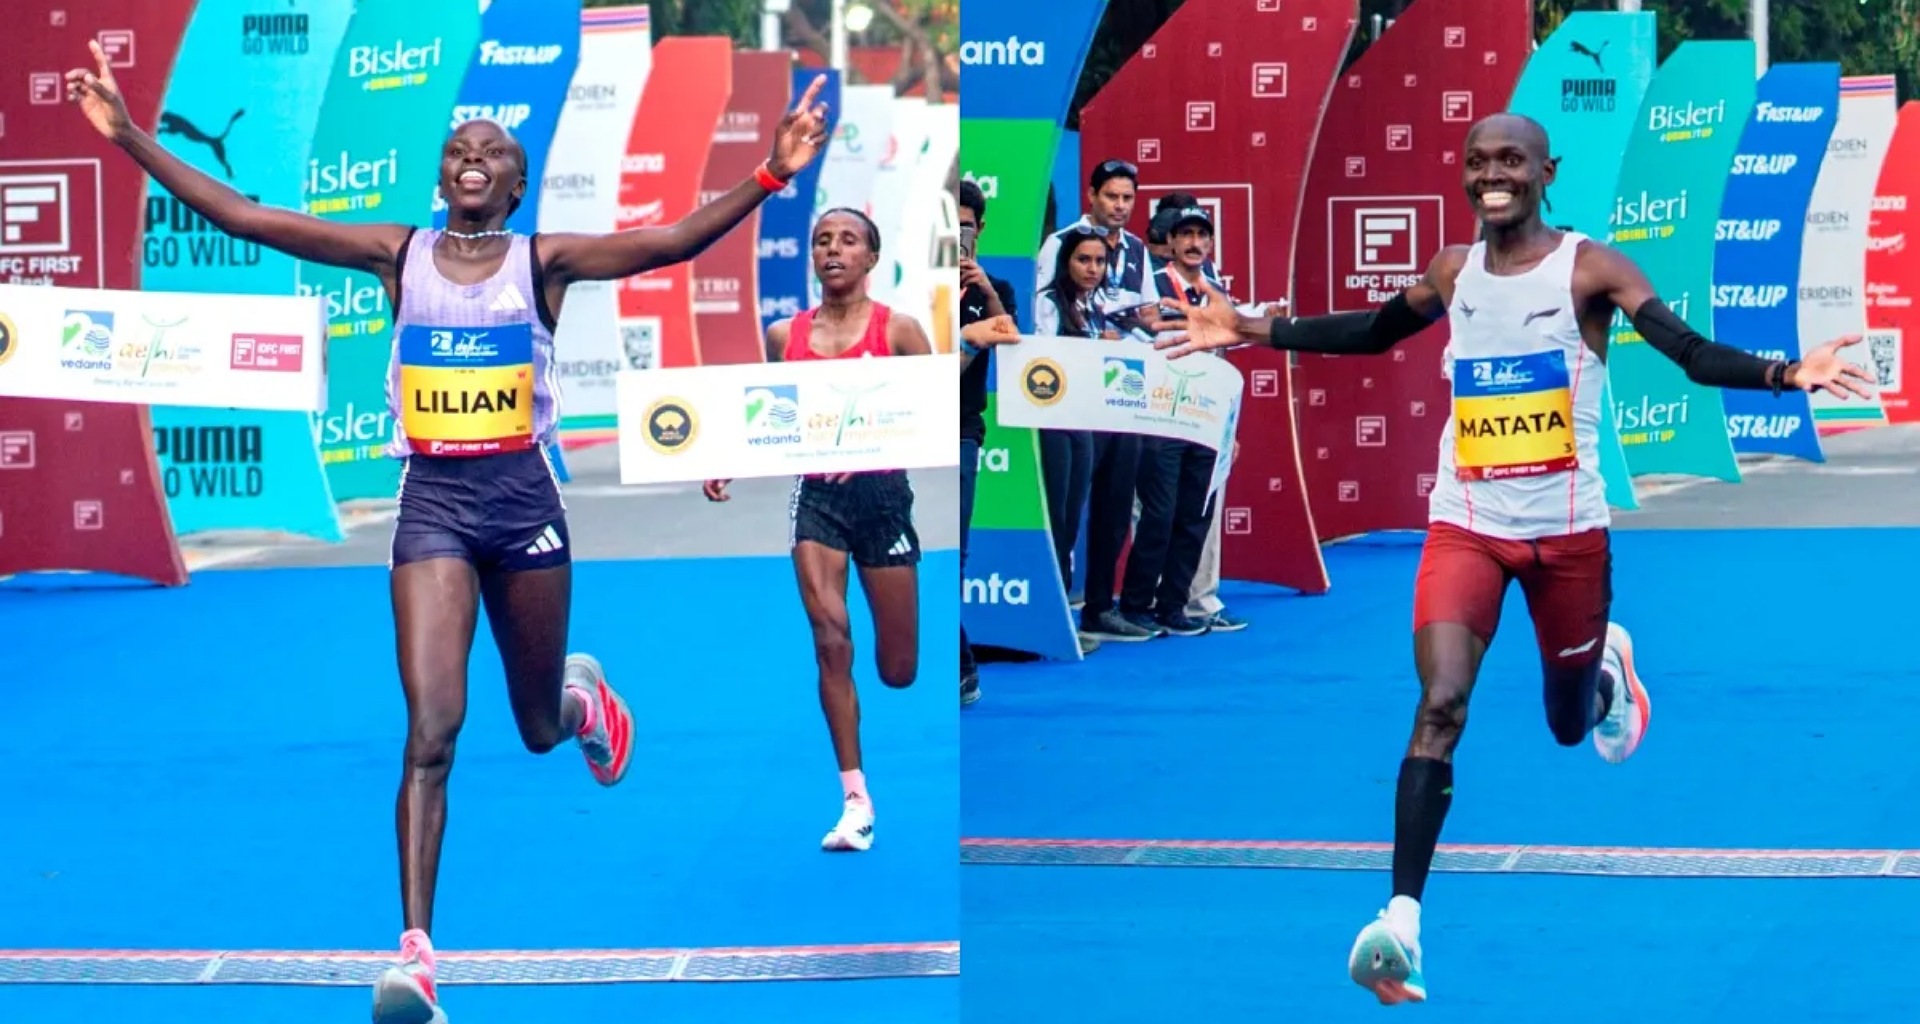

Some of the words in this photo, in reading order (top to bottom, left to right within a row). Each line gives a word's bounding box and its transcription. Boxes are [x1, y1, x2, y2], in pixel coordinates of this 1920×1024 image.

[242, 14, 309, 35] PUMA
[242, 38, 263, 54] GO
[269, 37, 309, 55] WILD
[350, 37, 441, 77] Bisleri
[960, 36, 1044, 65] anta
[1562, 79, 1616, 97] PUMA
[1561, 98, 1579, 112] GO
[1582, 98, 1616, 112] WILD
[1649, 99, 1725, 130] Bisleri
[303, 149, 398, 194] isleri
[1730, 154, 1797, 175] ST&UP
[1609, 189, 1688, 225] isleri
[1715, 219, 1781, 241] ST&UP
[144, 237, 180, 266] GO
[188, 235, 261, 266] WILD
[28, 256, 82, 273] FIRST
[1346, 275, 1380, 289] IDFC
[1384, 273, 1425, 288] FIRST
[60, 358, 112, 371] vedanta
[414, 387, 518, 414] LILIAN
[1104, 397, 1147, 409] vedanta
[1459, 411, 1567, 438] MATATA
[1723, 415, 1801, 438] ST&UP
[151, 426, 262, 464] PUMA
[747, 433, 802, 447] vedanta
[1563, 443, 1572, 453] 3
[190, 466, 263, 498] WILD
[961, 573, 1030, 604] nta
